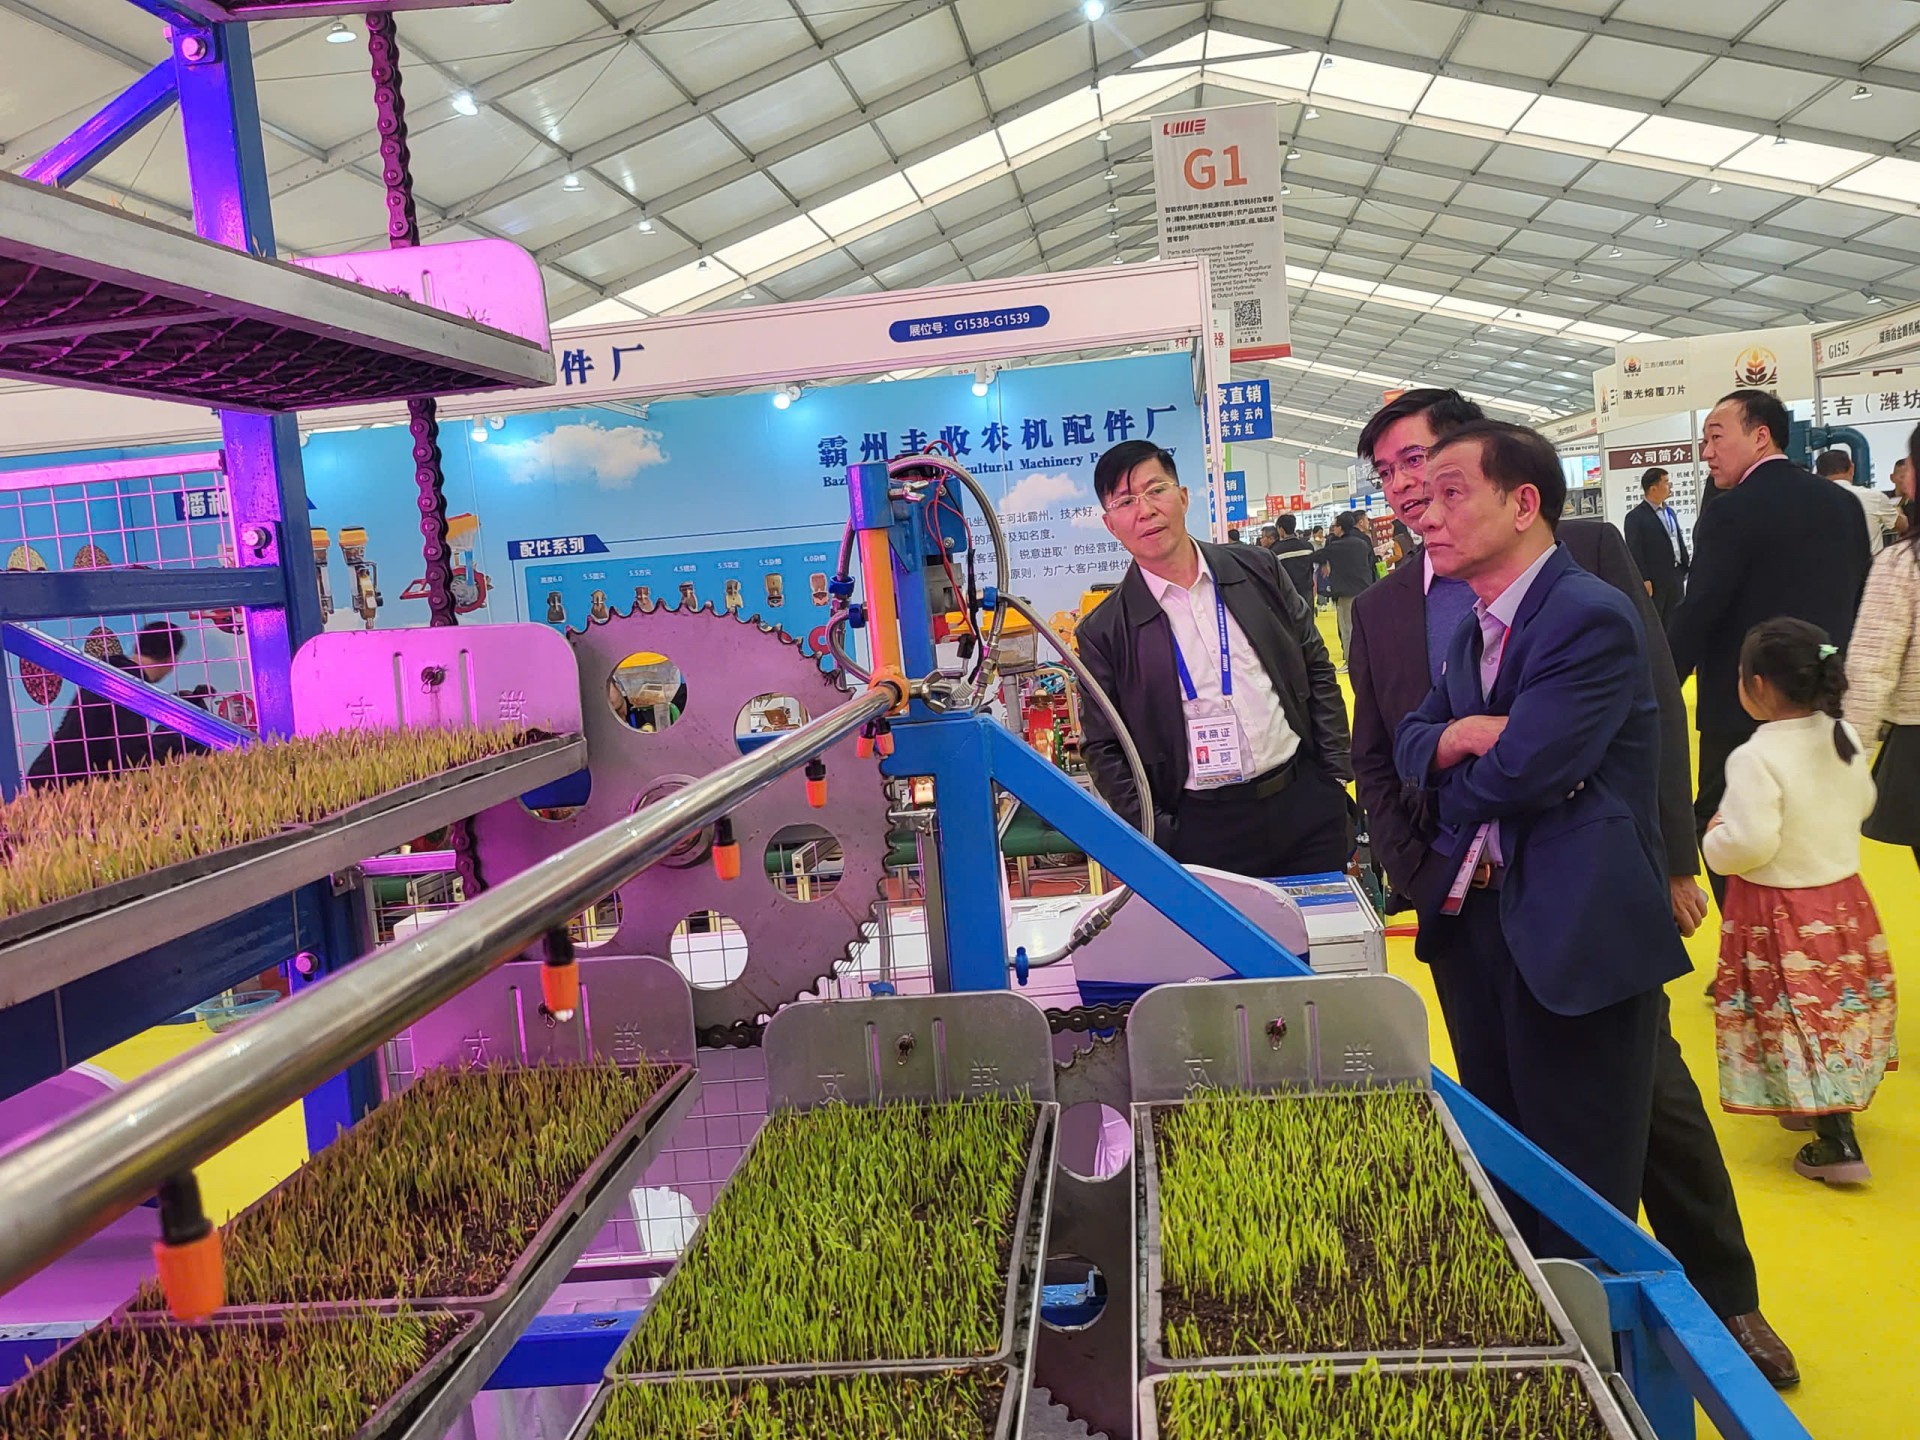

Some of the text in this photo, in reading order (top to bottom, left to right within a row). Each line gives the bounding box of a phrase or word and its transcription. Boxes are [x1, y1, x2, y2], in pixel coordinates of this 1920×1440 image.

[1184, 144, 1248, 191] G1
[1828, 340, 1850, 359] G1525
[560, 343, 645, 386] 件厂
[1623, 384, 1686, 400] 激光熔覆刀片
[1244, 406, 1263, 420] 云内
[818, 404, 1177, 468] 霸州丰收农机配件厂
[1221, 422, 1255, 438] 东方红
[1020, 456, 1084, 471] Machinery
[519, 537, 585, 558] 配件系列
[1197, 727, 1231, 741] 展商证
